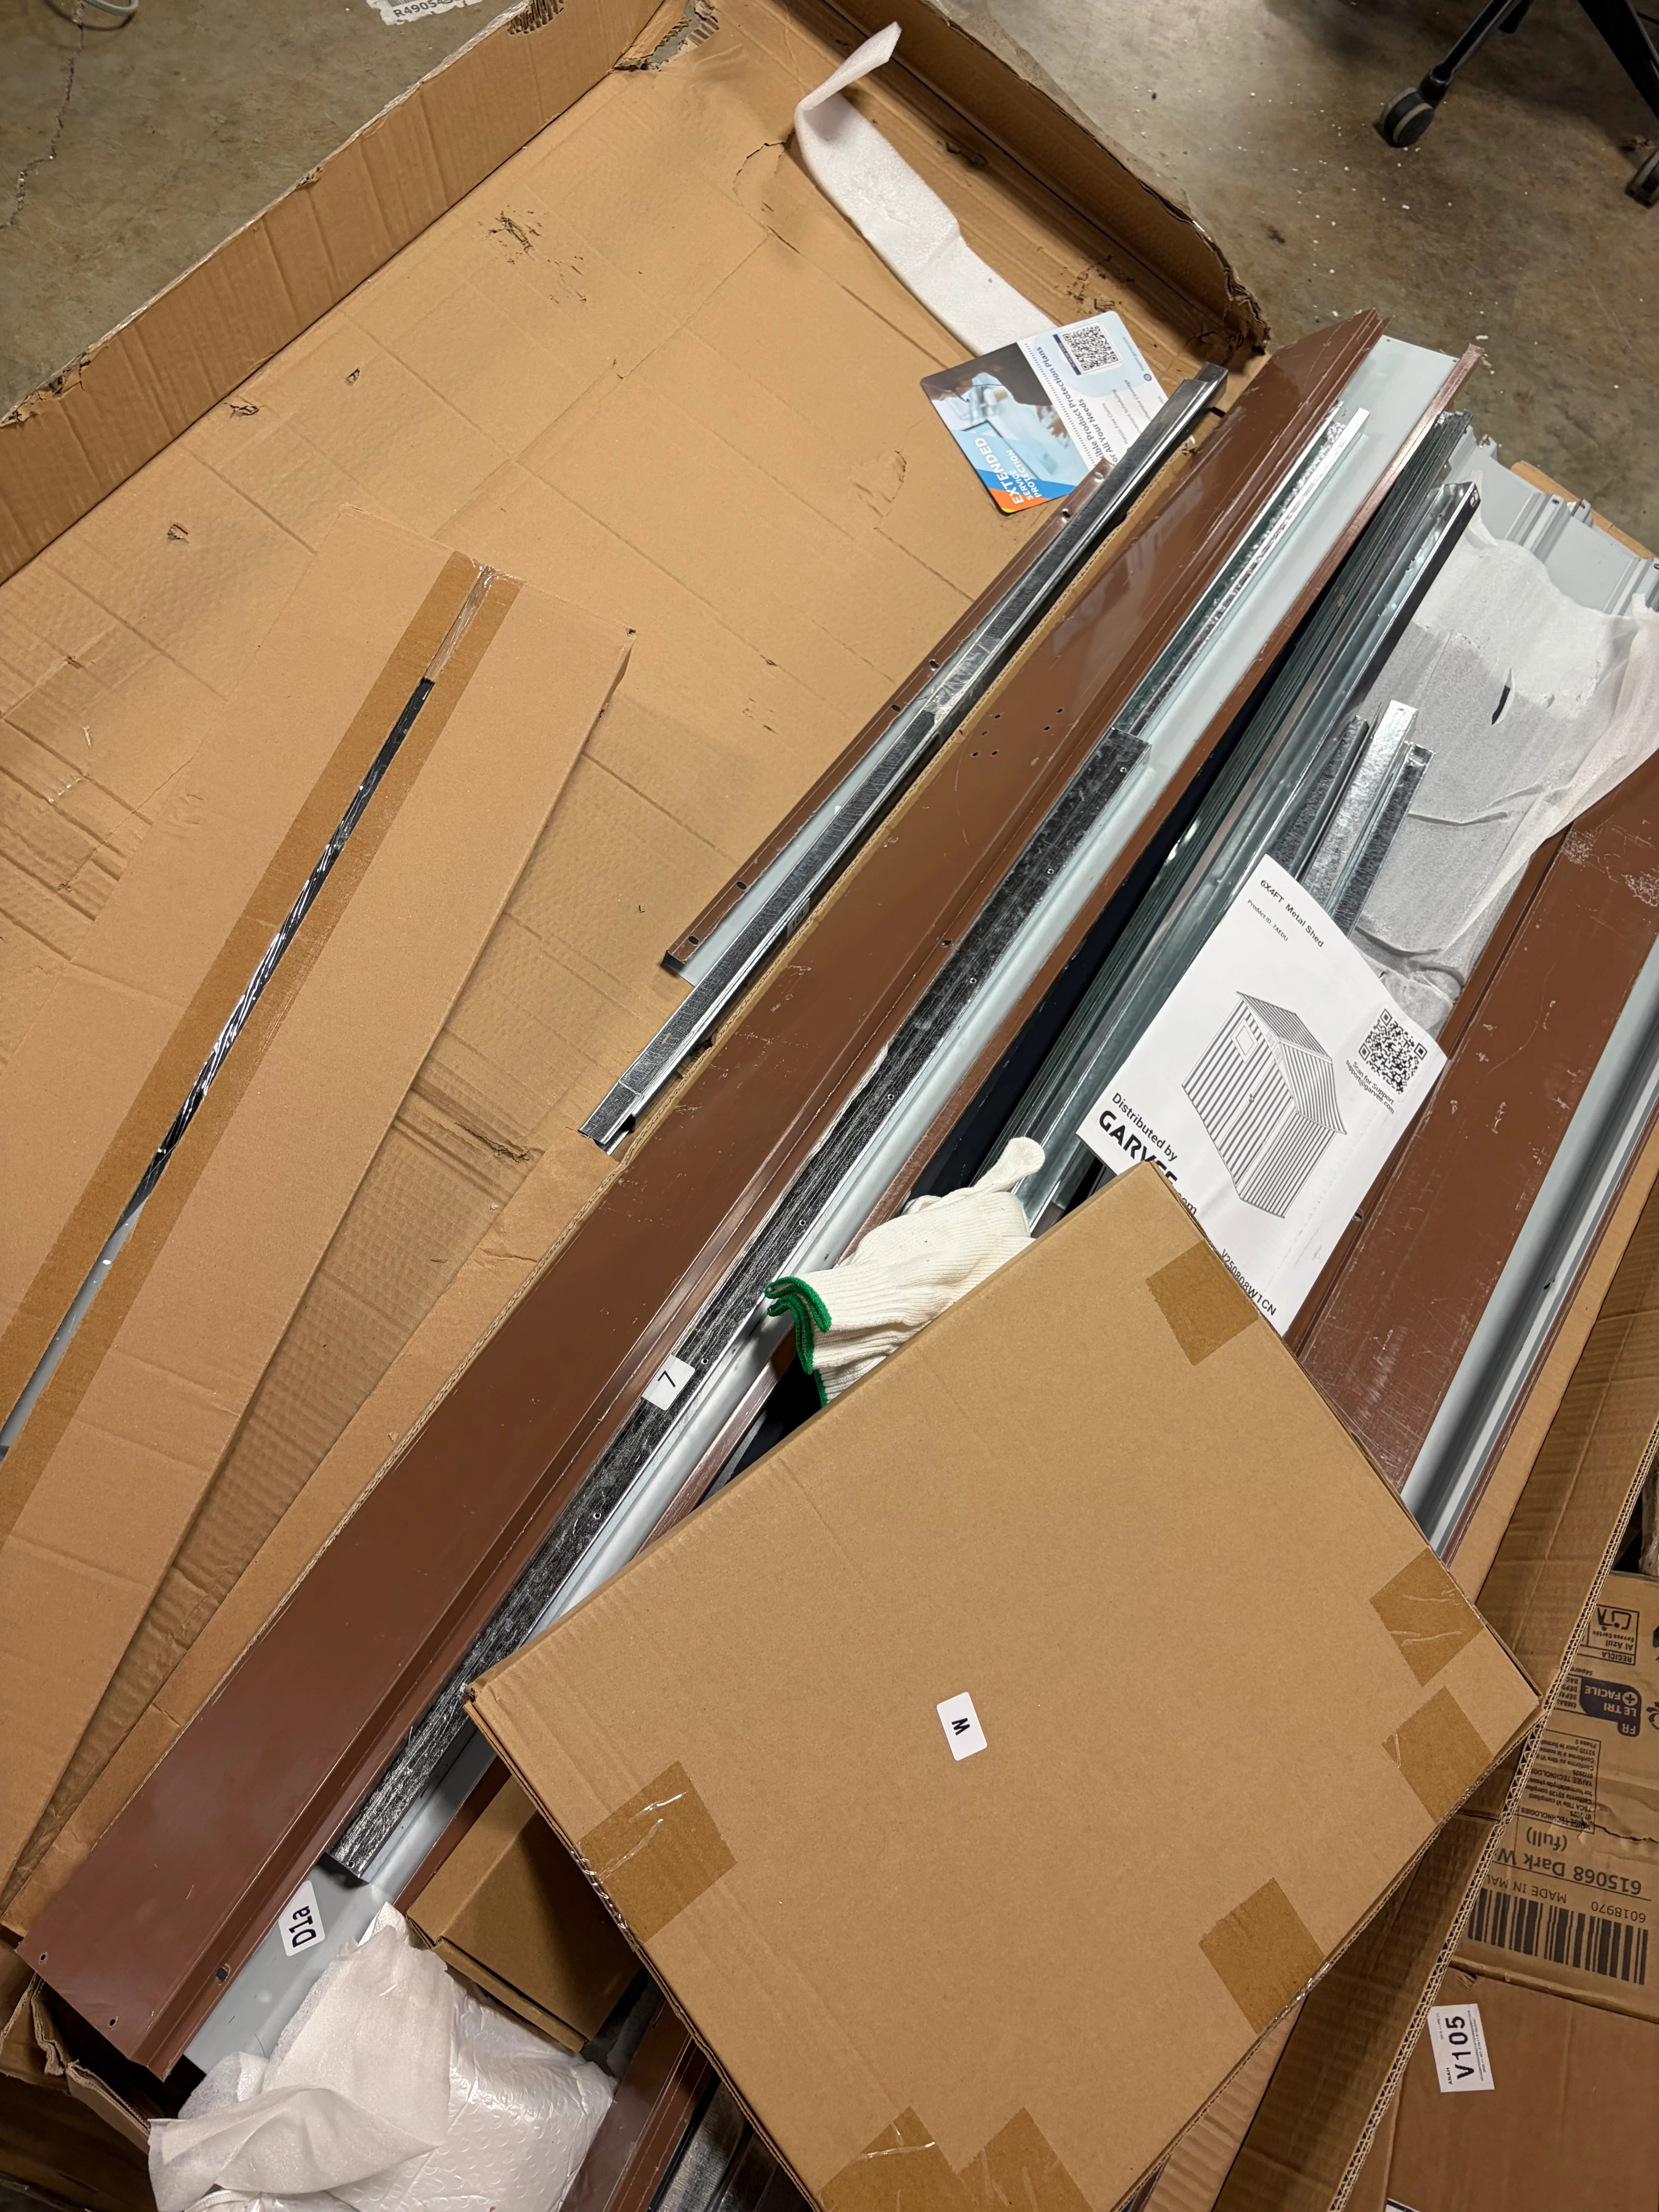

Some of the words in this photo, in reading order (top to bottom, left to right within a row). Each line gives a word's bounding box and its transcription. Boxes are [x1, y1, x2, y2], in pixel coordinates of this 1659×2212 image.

[1036, 346, 1052, 368] Plans
[1048, 368, 1077, 408] Protection
[1078, 398, 1095, 422] Needs
[1072, 408, 1094, 440] Product
[1091, 423, 1106, 442] Your
[1101, 442, 1113, 452] All
[974, 438, 1024, 504] EXTENDED
[1006, 449, 1042, 498] PROTECTION
[1009, 469, 1034, 500] SERVICE
[1259, 880, 1284, 903] 6X4FT
[1284, 904, 1307, 927] Metal
[1304, 926, 1324, 948] Shed
[1346, 1060, 1395, 1114] support@garvee.com
[1352, 1062, 1364, 1077] Scan
[1363, 1075, 1372, 1085] for
[1371, 1083, 1394, 1104] Support
[1111, 1092, 1166, 1149] Distributed
[1163, 1145, 1178, 1161] by
[657, 1370, 675, 1388] 7
[1605, 1640, 1622, 1648] Azul
[1601, 1651, 1632, 1662] RECICLA
[1583, 1685, 1621, 1700] FACILE
[1603, 1702, 1621, 1713] TRI
[1624, 1706, 1636, 1716] LE
[1621, 1723, 1636, 1735] FR
[1572, 1777, 1591, 1786] YAHEE
[1525, 1827, 1568, 1852] (full)
[1522, 1853, 1565, 1877] Dark
[1513, 1882, 1526, 1893] IN
[1572, 1865, 1642, 1895] 615068
[1531, 1885, 1566, 1903] MADE
[1590, 1901, 1646, 1923] 6018970
[288, 1906, 316, 1948] D1a
[1445, 2015, 1474, 2079] V105
